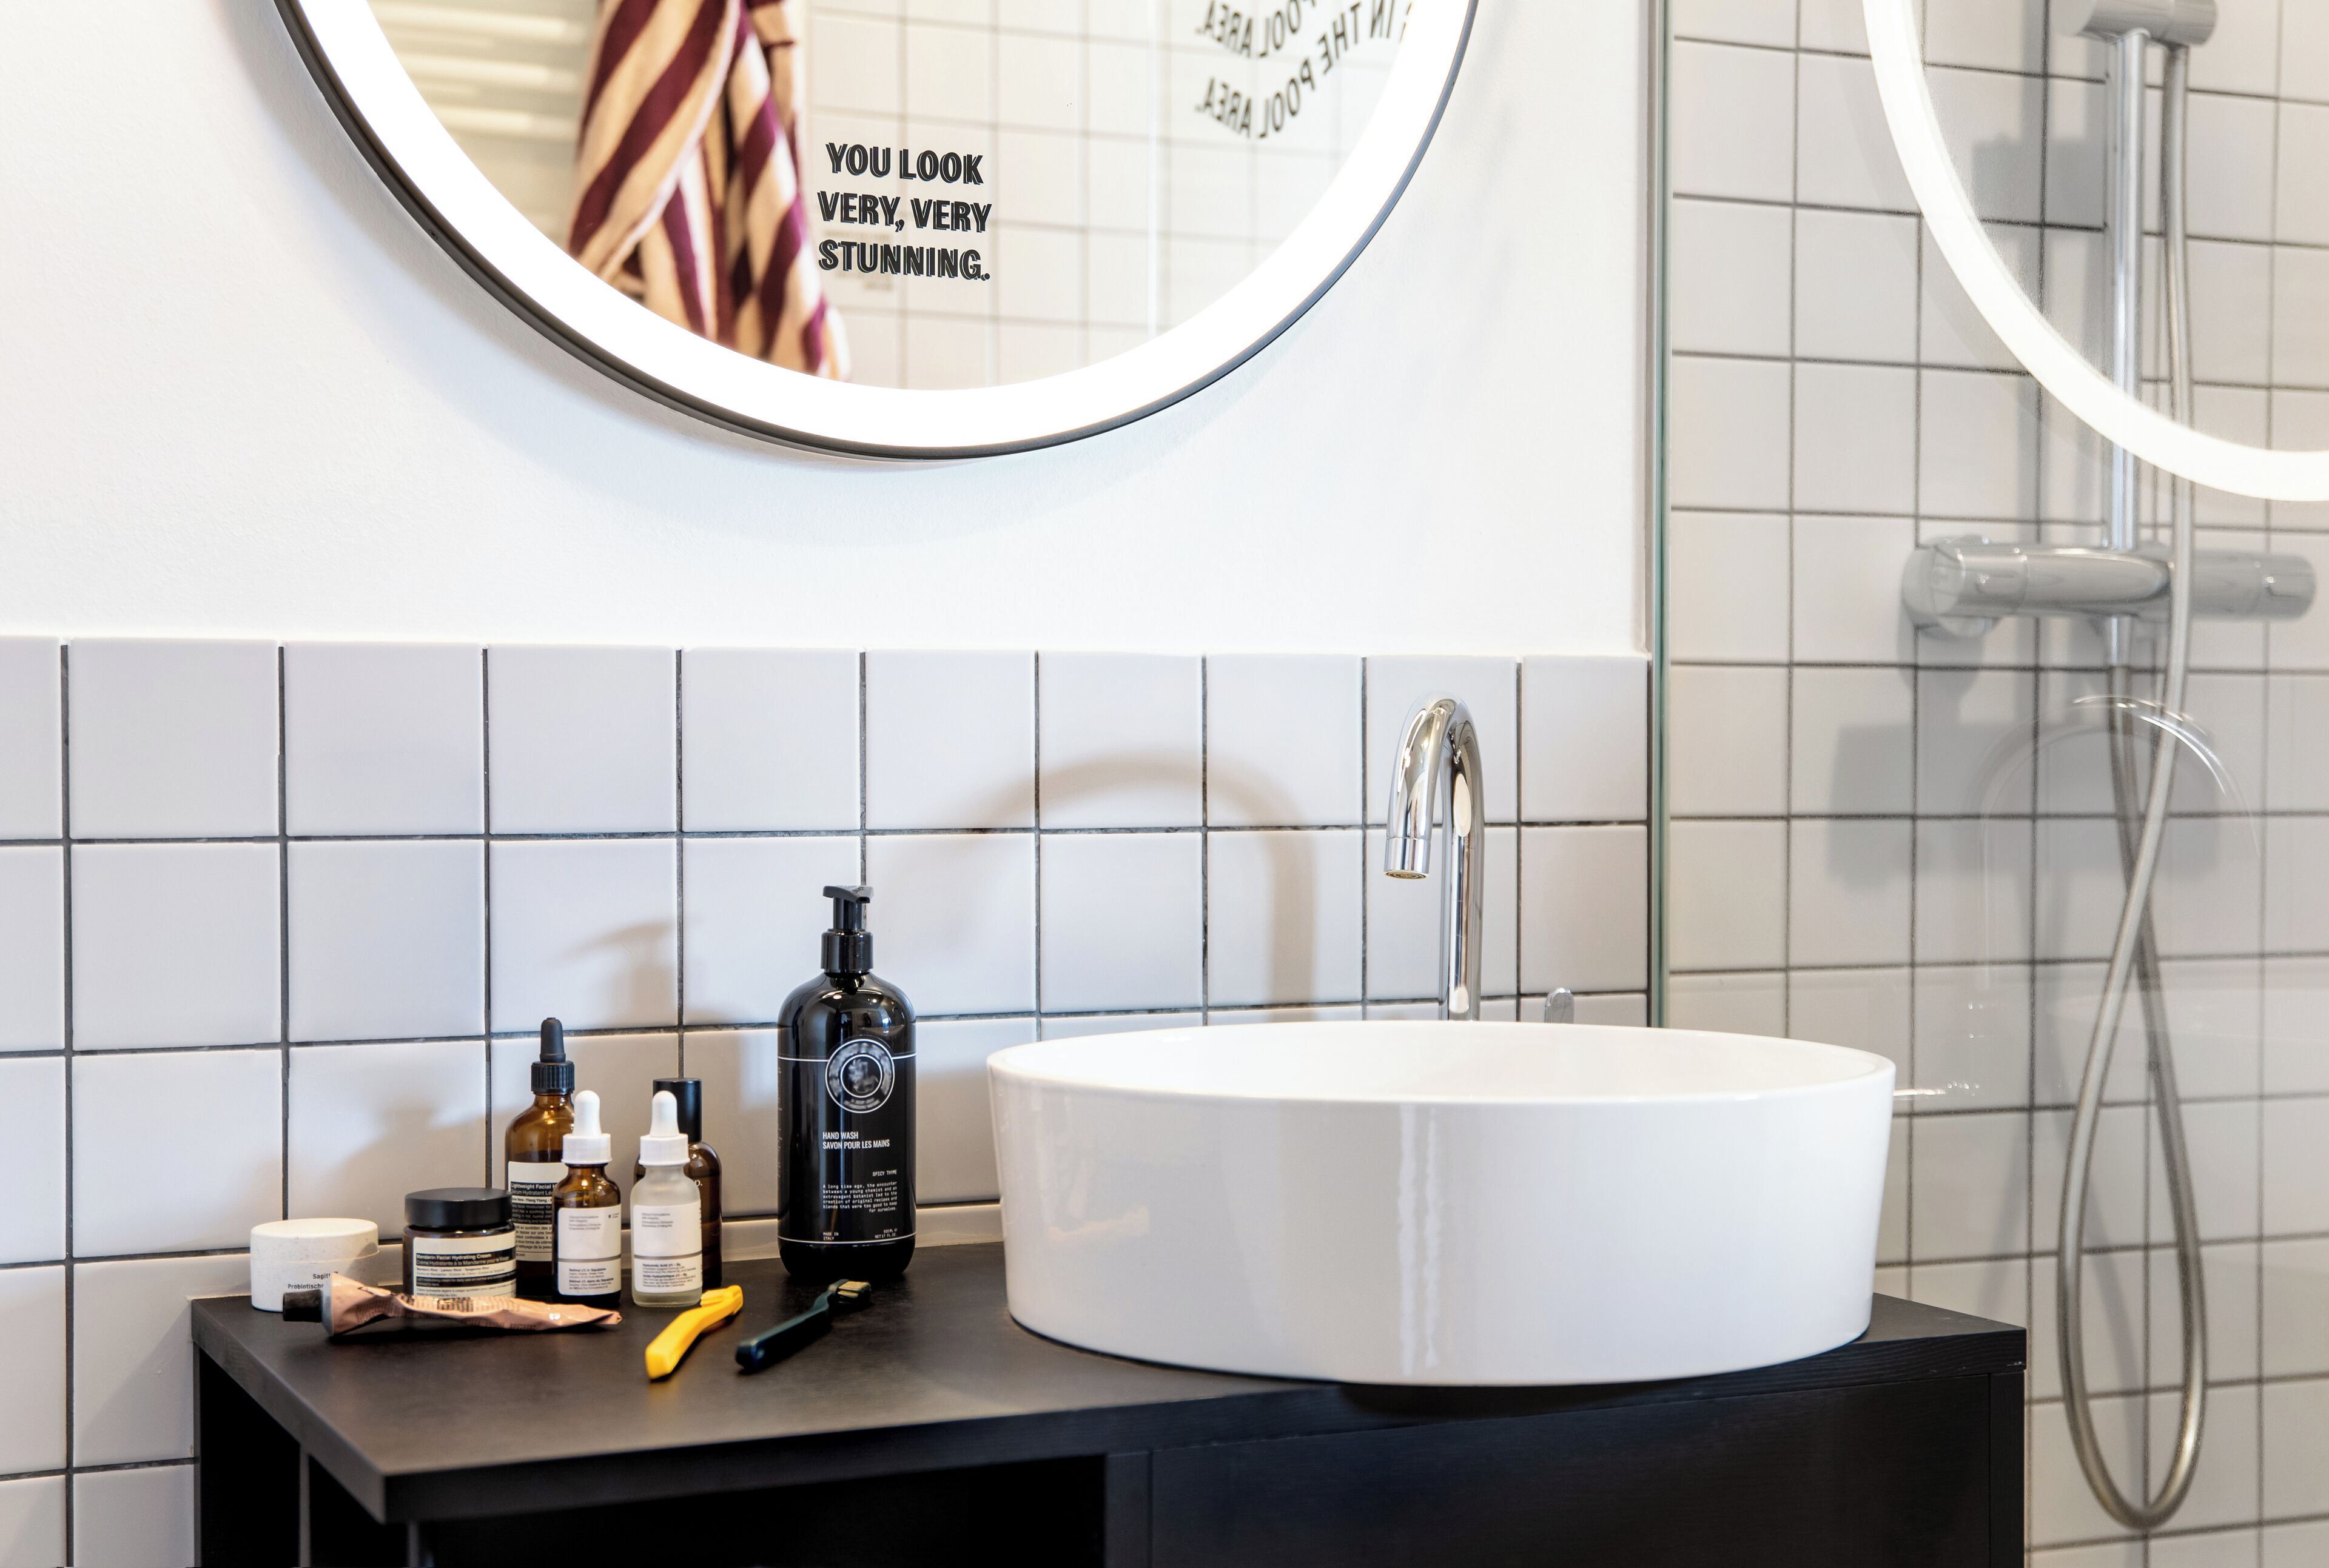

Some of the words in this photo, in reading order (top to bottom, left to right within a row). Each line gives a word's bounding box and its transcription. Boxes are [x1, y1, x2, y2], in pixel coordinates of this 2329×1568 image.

[825, 142, 891, 178] YOU
[899, 149, 984, 185] LOOK
[817, 191, 904, 233] VERY,
[910, 198, 992, 233] VERY
[818, 240, 990, 281] STUNNING.
[822, 1131, 839, 1140] HAND
[822, 1141, 842, 1150] SAVON
[873, 1139, 890, 1148] MAINS
